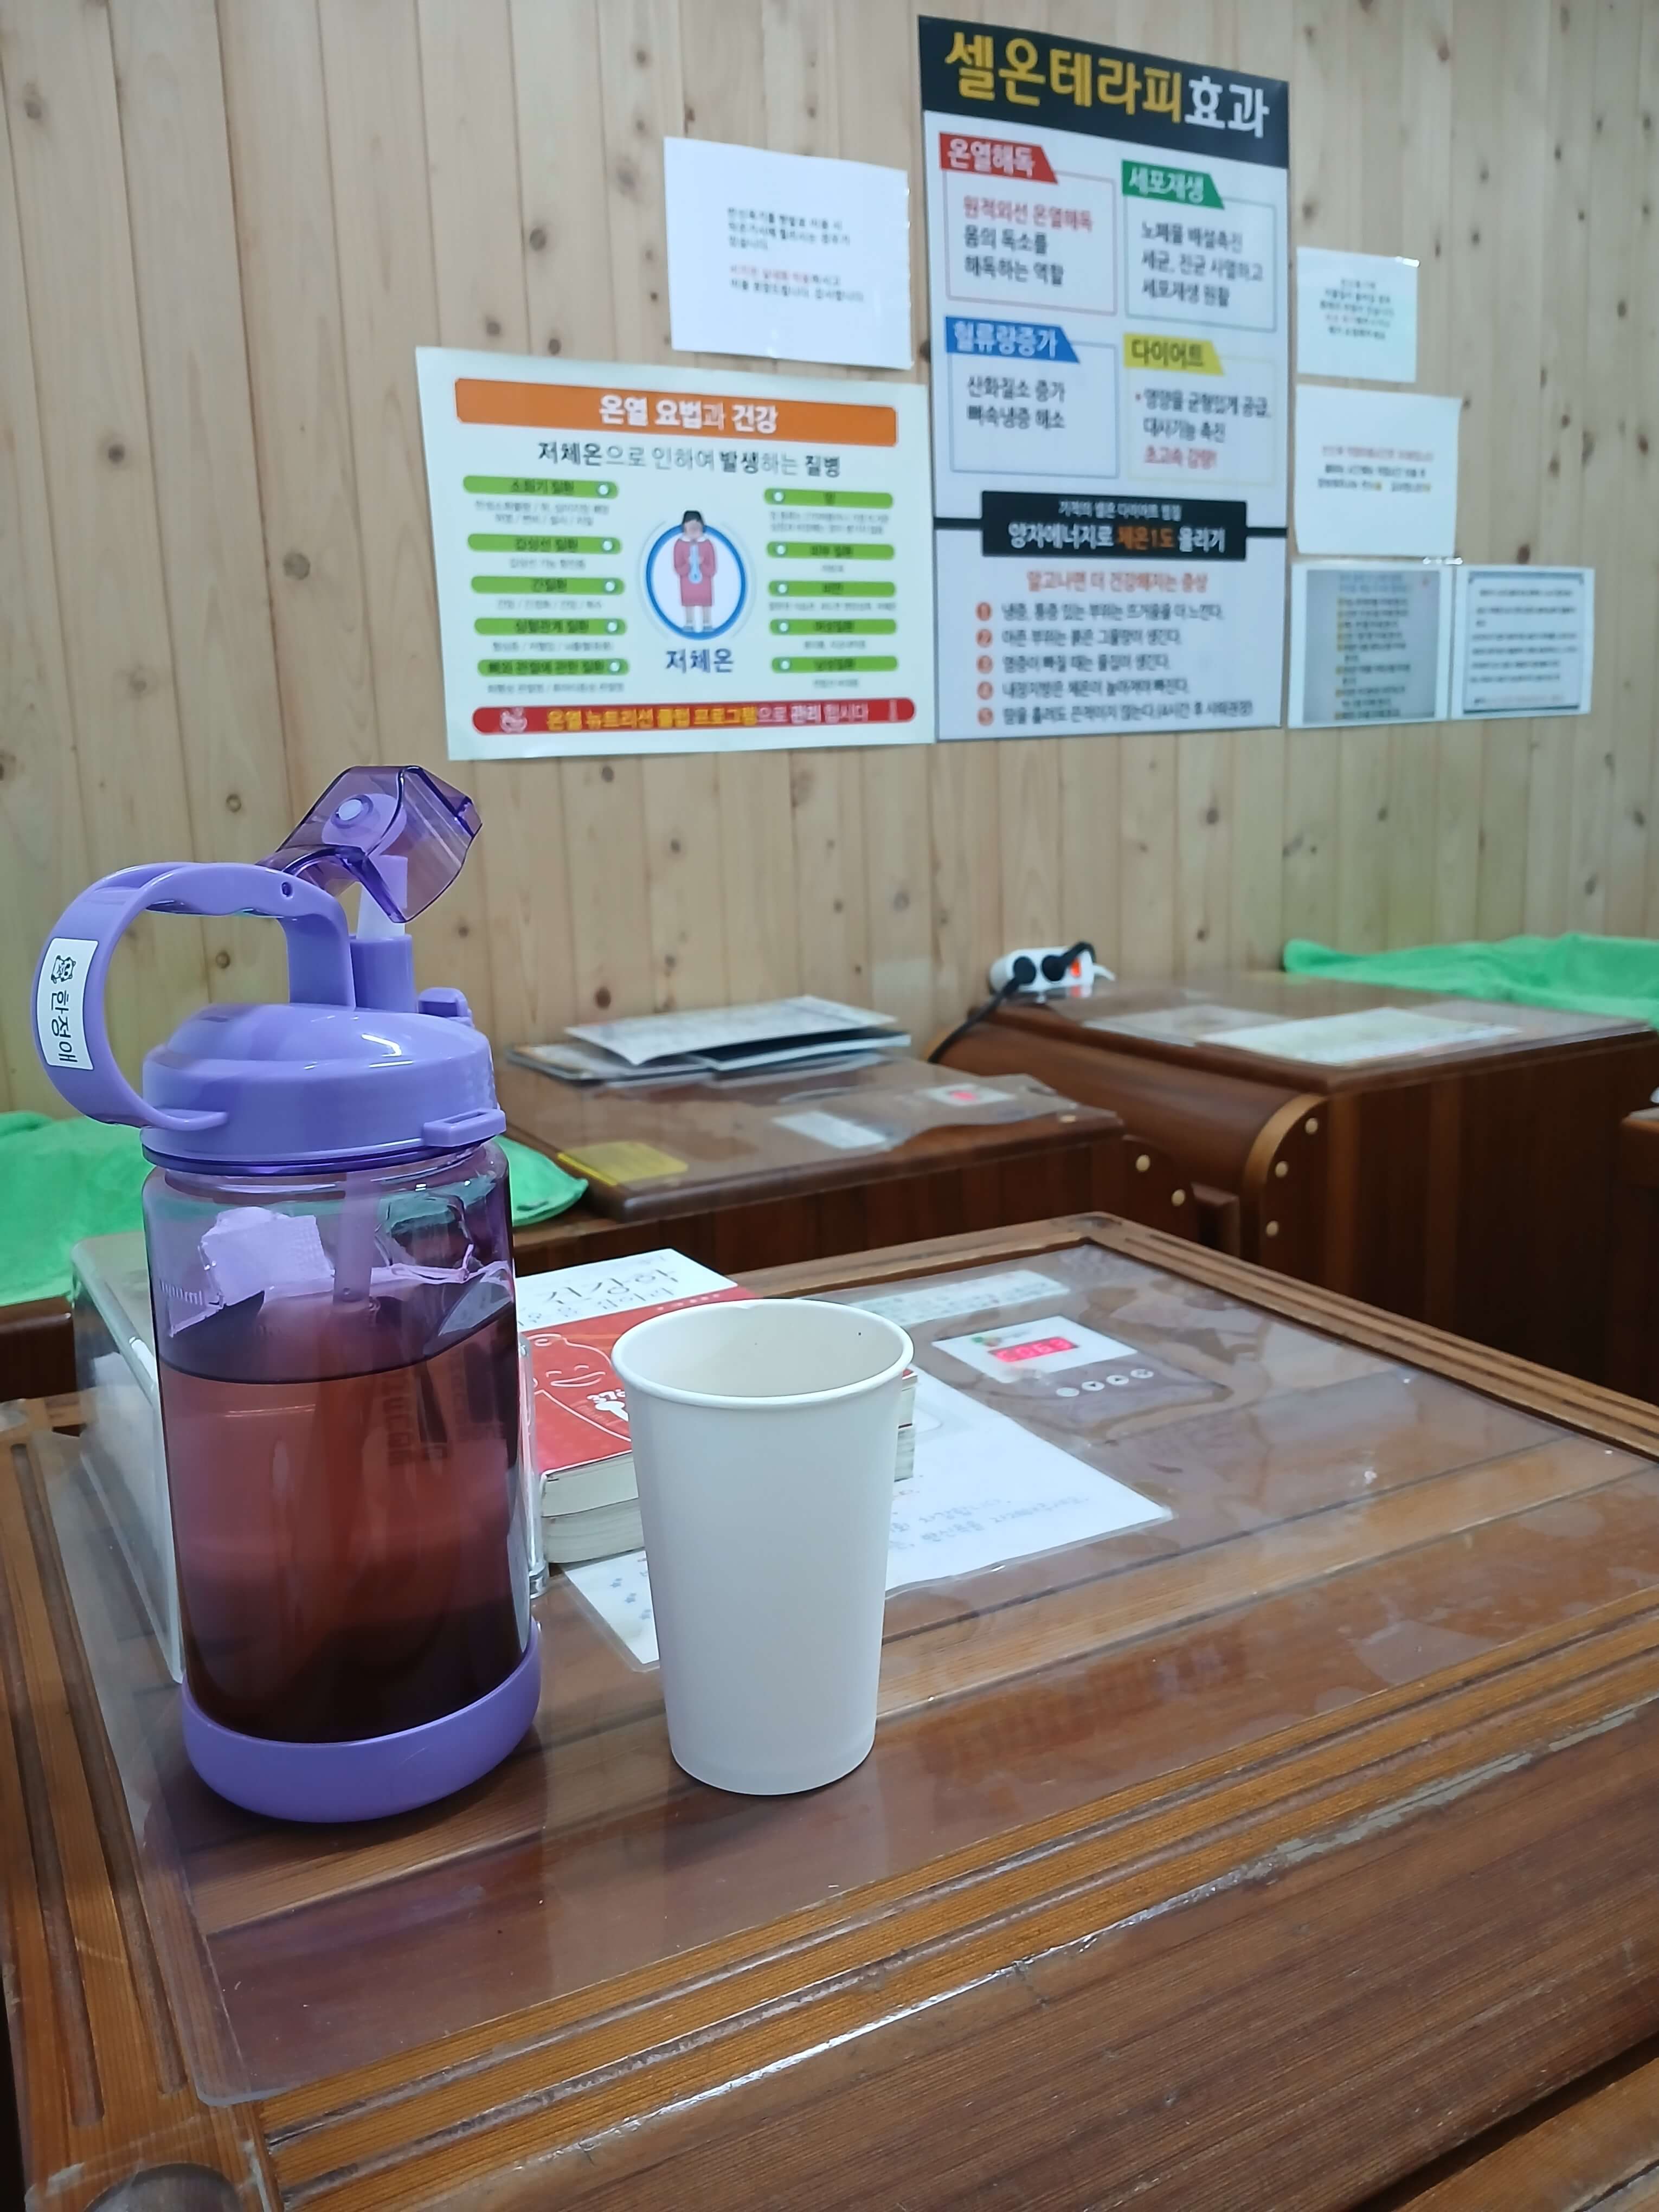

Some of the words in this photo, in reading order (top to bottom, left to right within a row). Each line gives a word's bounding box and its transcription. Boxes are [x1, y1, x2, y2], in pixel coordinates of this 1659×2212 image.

[964, 224, 996, 249] 몸의
[1001, 228, 1047, 255] 독소를
[964, 255, 1028, 282] 해독하는
[1033, 261, 1064, 287] 역할
[1131, 338, 1205, 368] 다이어트
[1034, 378, 1065, 402] 증가
[599, 394, 649, 427] 온열
[654, 399, 726, 431] 요법과
[731, 403, 779, 434] 건강
[538, 441, 647, 467] 저체온으로
[652, 444, 715, 471] 인하여
[719, 450, 799, 475] 발생하는
[805, 454, 840, 478] 질병
[1178, 526, 1226, 552] 올리기
[666, 648, 735, 673] 저체온
[51, 990, 78, 1063] 한정애
